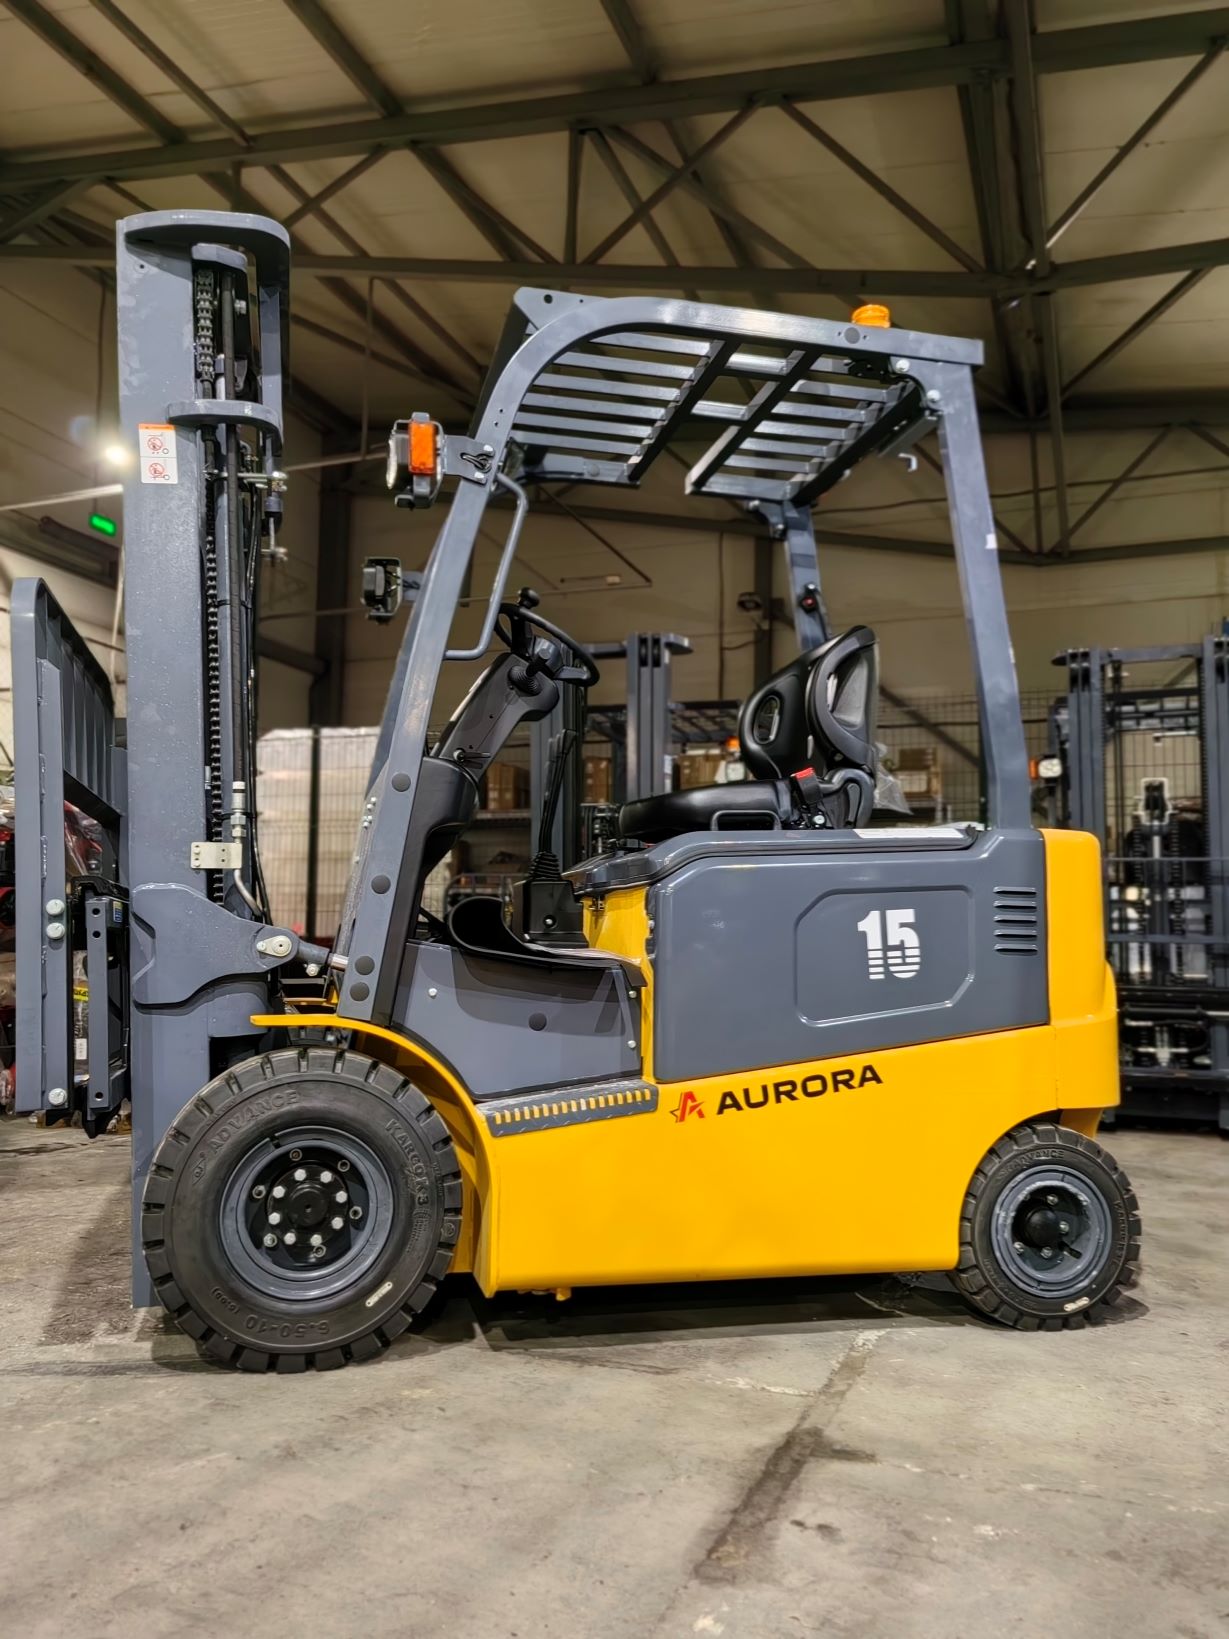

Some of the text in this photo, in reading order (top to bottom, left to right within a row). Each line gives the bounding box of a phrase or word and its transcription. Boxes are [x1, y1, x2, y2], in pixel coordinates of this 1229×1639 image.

[857, 908, 922, 980] 15
[208, 1089, 298, 1155] ADVANCE
[716, 1064, 884, 1115] AURORA
